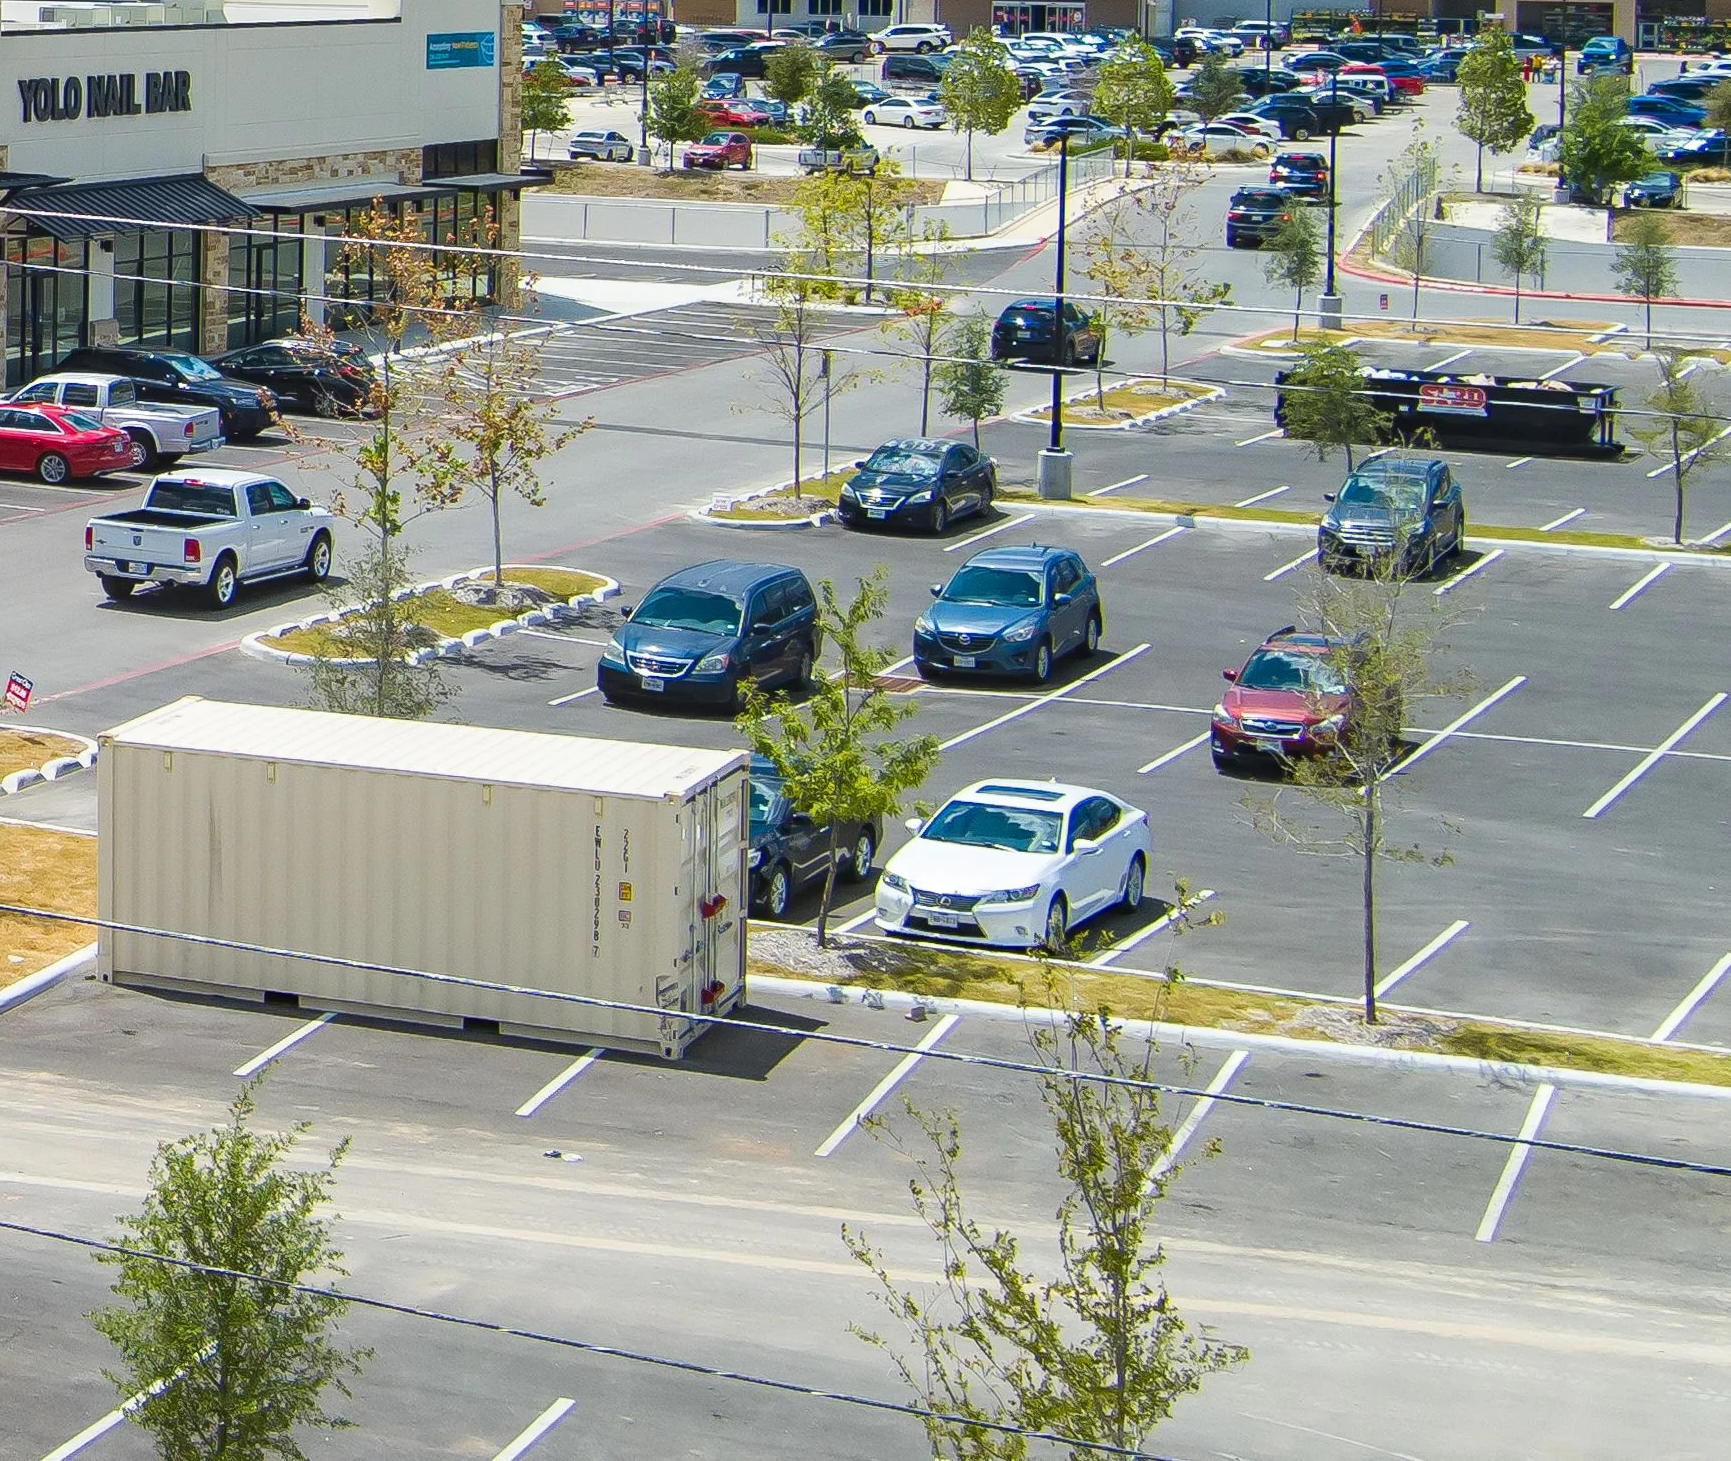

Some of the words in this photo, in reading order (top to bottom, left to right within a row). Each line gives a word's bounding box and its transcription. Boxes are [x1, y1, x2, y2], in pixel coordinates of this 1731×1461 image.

[18, 76, 85, 123] YOLO
[86, 73, 143, 118] NAIL
[145, 70, 193, 114] BAR
